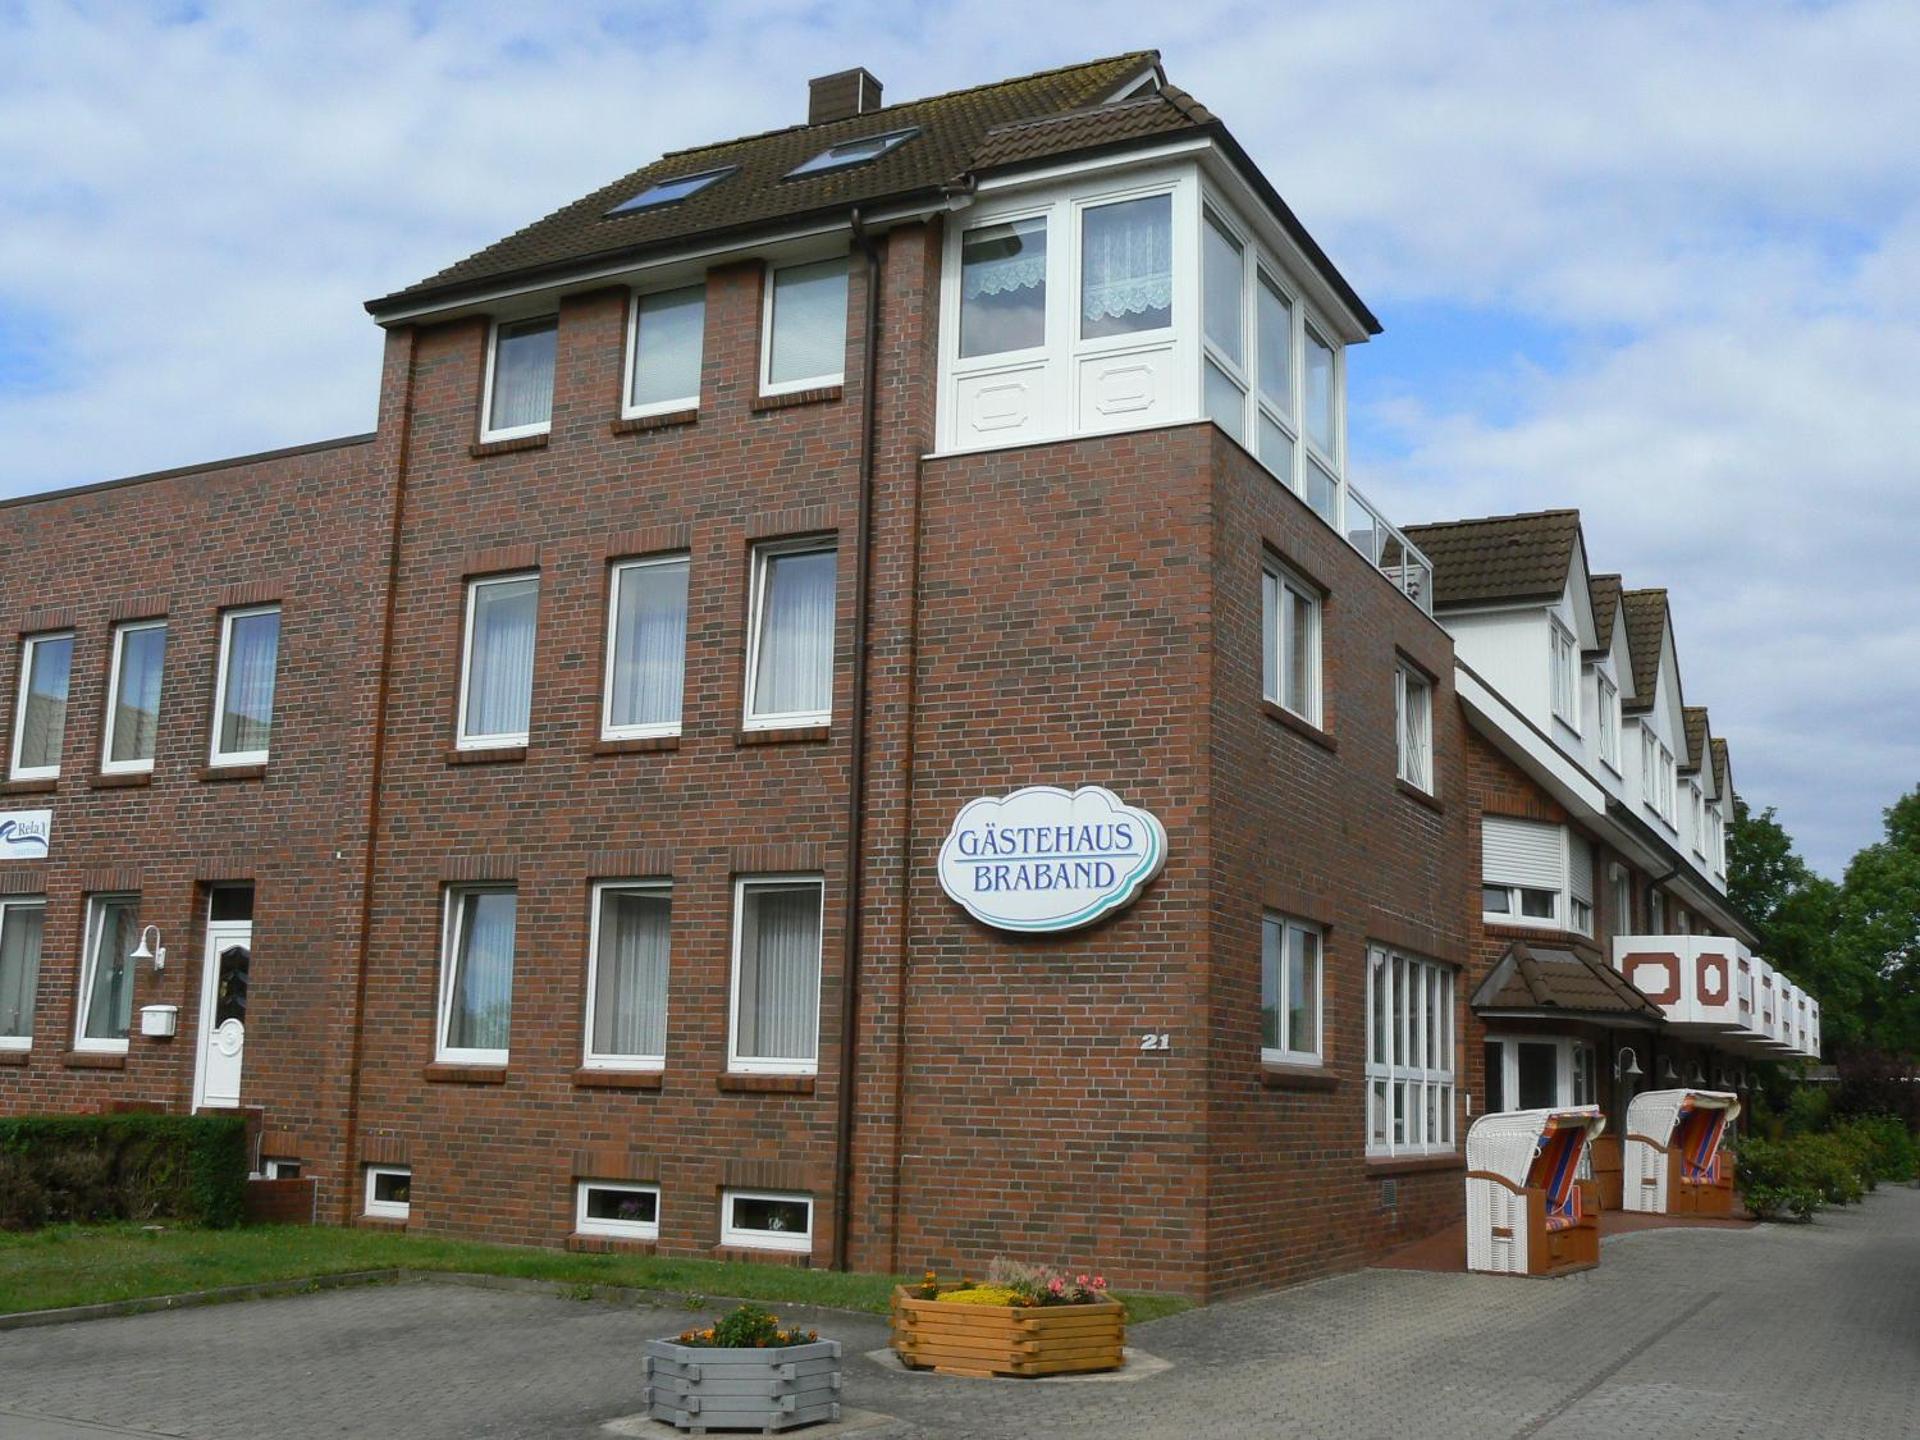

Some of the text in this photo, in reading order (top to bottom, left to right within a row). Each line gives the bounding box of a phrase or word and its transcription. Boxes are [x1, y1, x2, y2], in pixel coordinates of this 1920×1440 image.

[958, 823, 1133, 856] GÄSTEHAUS
[973, 862, 1115, 892] BRABAND
[1140, 1033, 1170, 1050] 21
